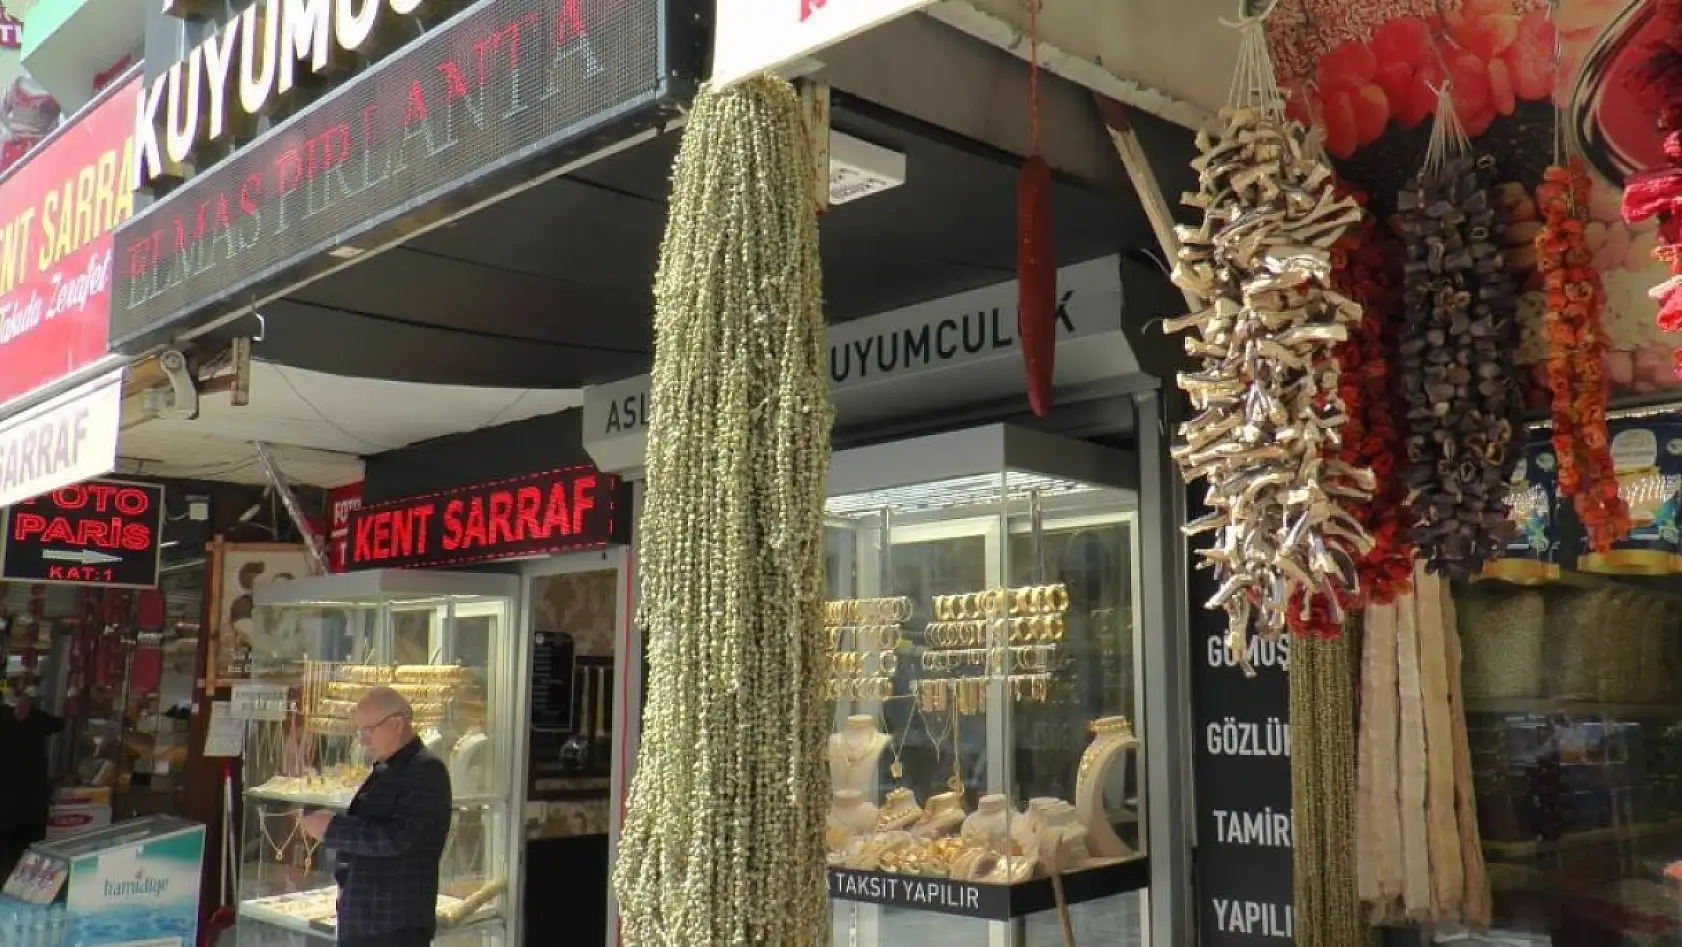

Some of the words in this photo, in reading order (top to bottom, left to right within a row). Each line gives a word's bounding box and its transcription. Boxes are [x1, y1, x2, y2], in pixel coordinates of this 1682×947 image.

[132, 0, 423, 190] KUYUM
[0, 206, 36, 296] NT
[831, 289, 1076, 382] UYUMCULK
[0, 406, 89, 492] ARRAF
[16, 484, 149, 515] OTO
[353, 503, 434, 562] KENT
[442, 474, 597, 550] SARRAF
[903, 880, 979, 910] YAPILIR
